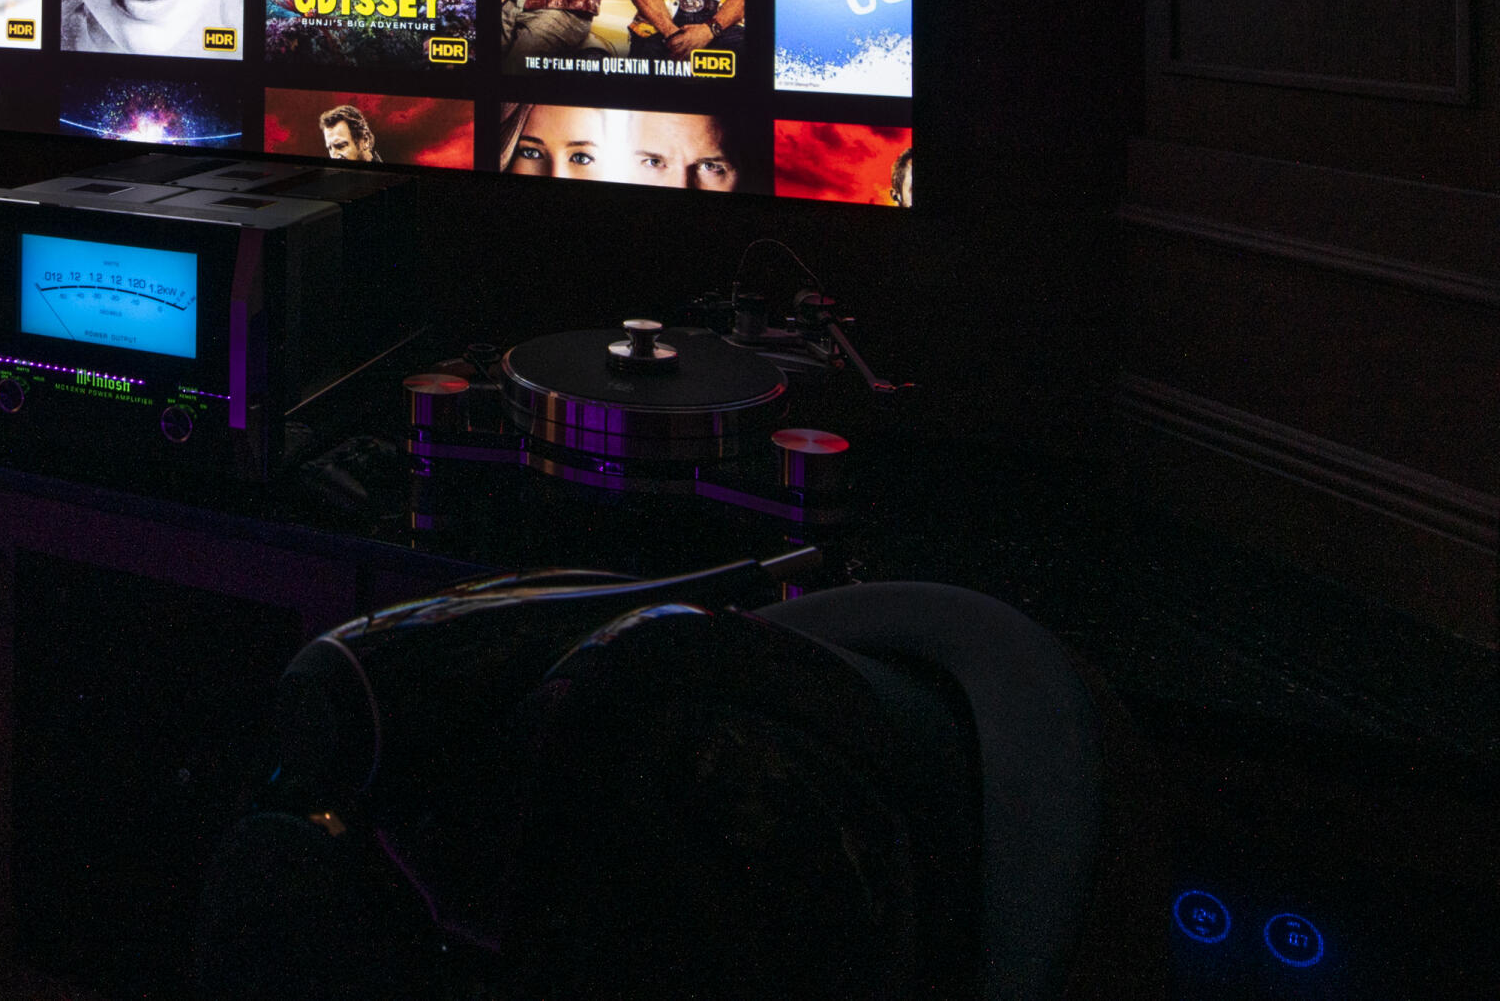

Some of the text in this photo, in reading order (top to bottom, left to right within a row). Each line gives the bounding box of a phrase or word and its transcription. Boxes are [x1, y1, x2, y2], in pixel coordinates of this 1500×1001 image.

[8, 22, 33, 36] HDR
[301, 17, 437, 31] BUNJI'S BIG ADVENTURE
[205, 32, 234, 46] HDR
[432, 42, 465, 58] HDR
[525, 56, 650, 76] THE FILM FROM QUENTIN
[693, 56, 732, 71] HDR
